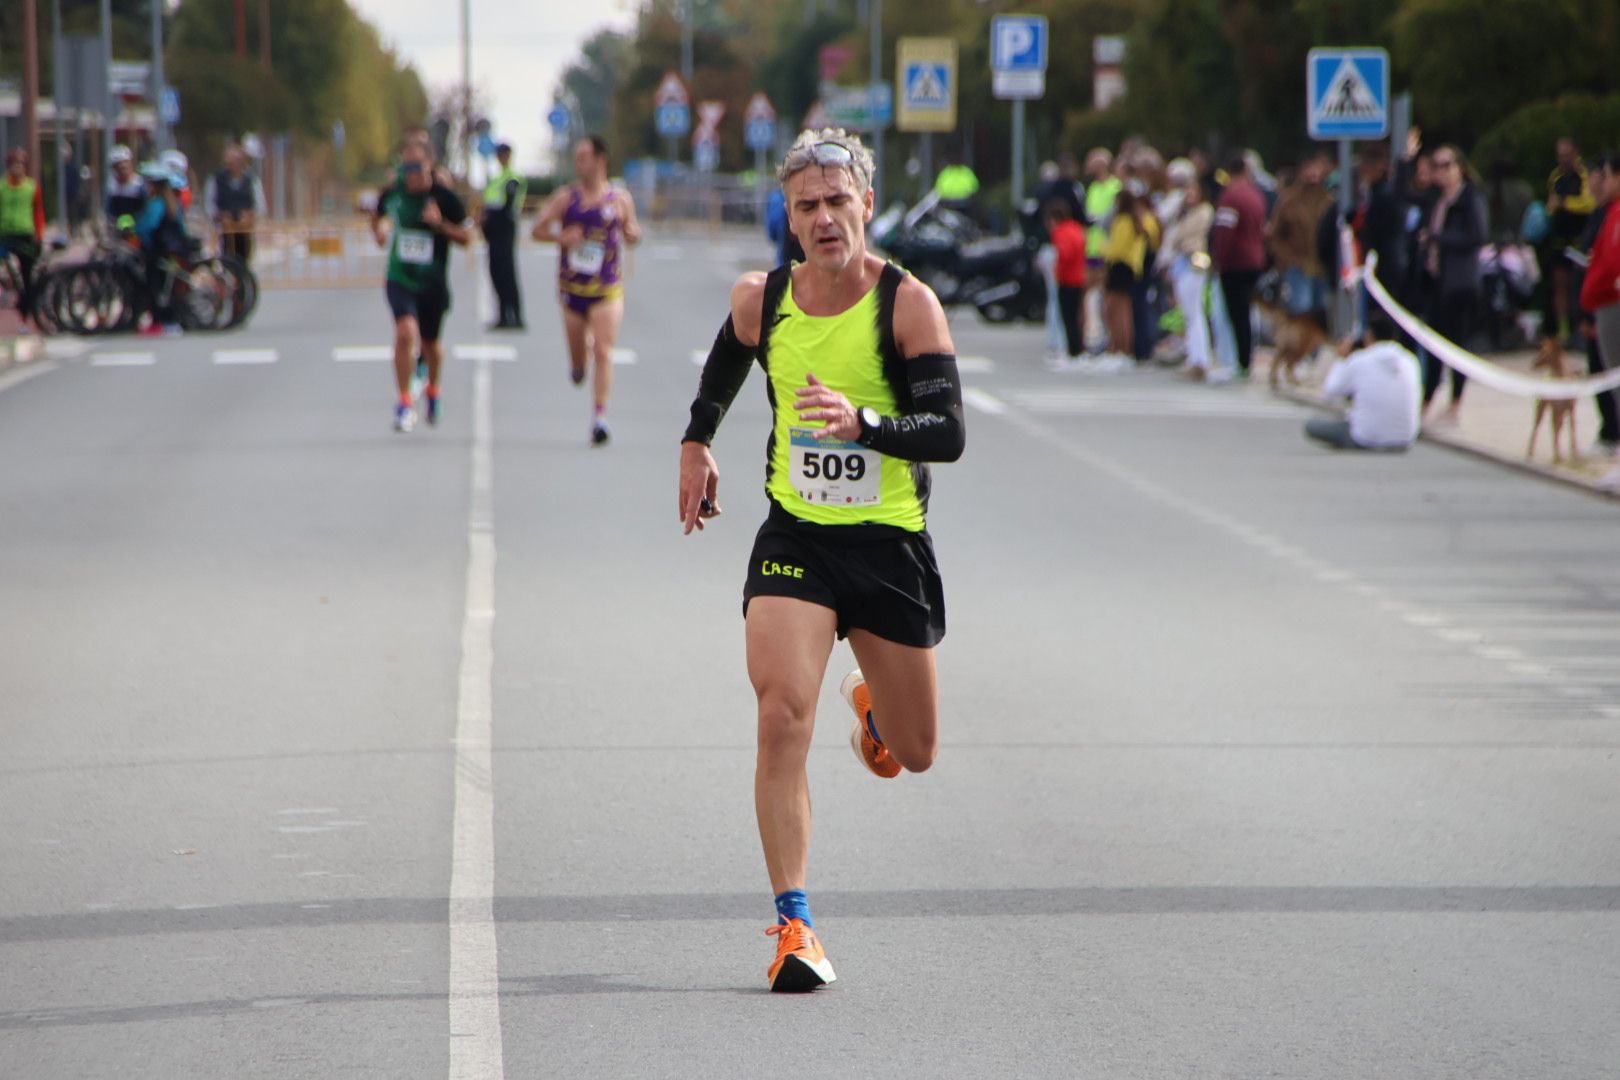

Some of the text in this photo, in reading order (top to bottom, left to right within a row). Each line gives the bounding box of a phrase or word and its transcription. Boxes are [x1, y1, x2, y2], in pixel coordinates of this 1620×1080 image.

[1000, 21, 1034, 68] P
[802, 452, 866, 482] 509
[762, 560, 804, 579] CASE
